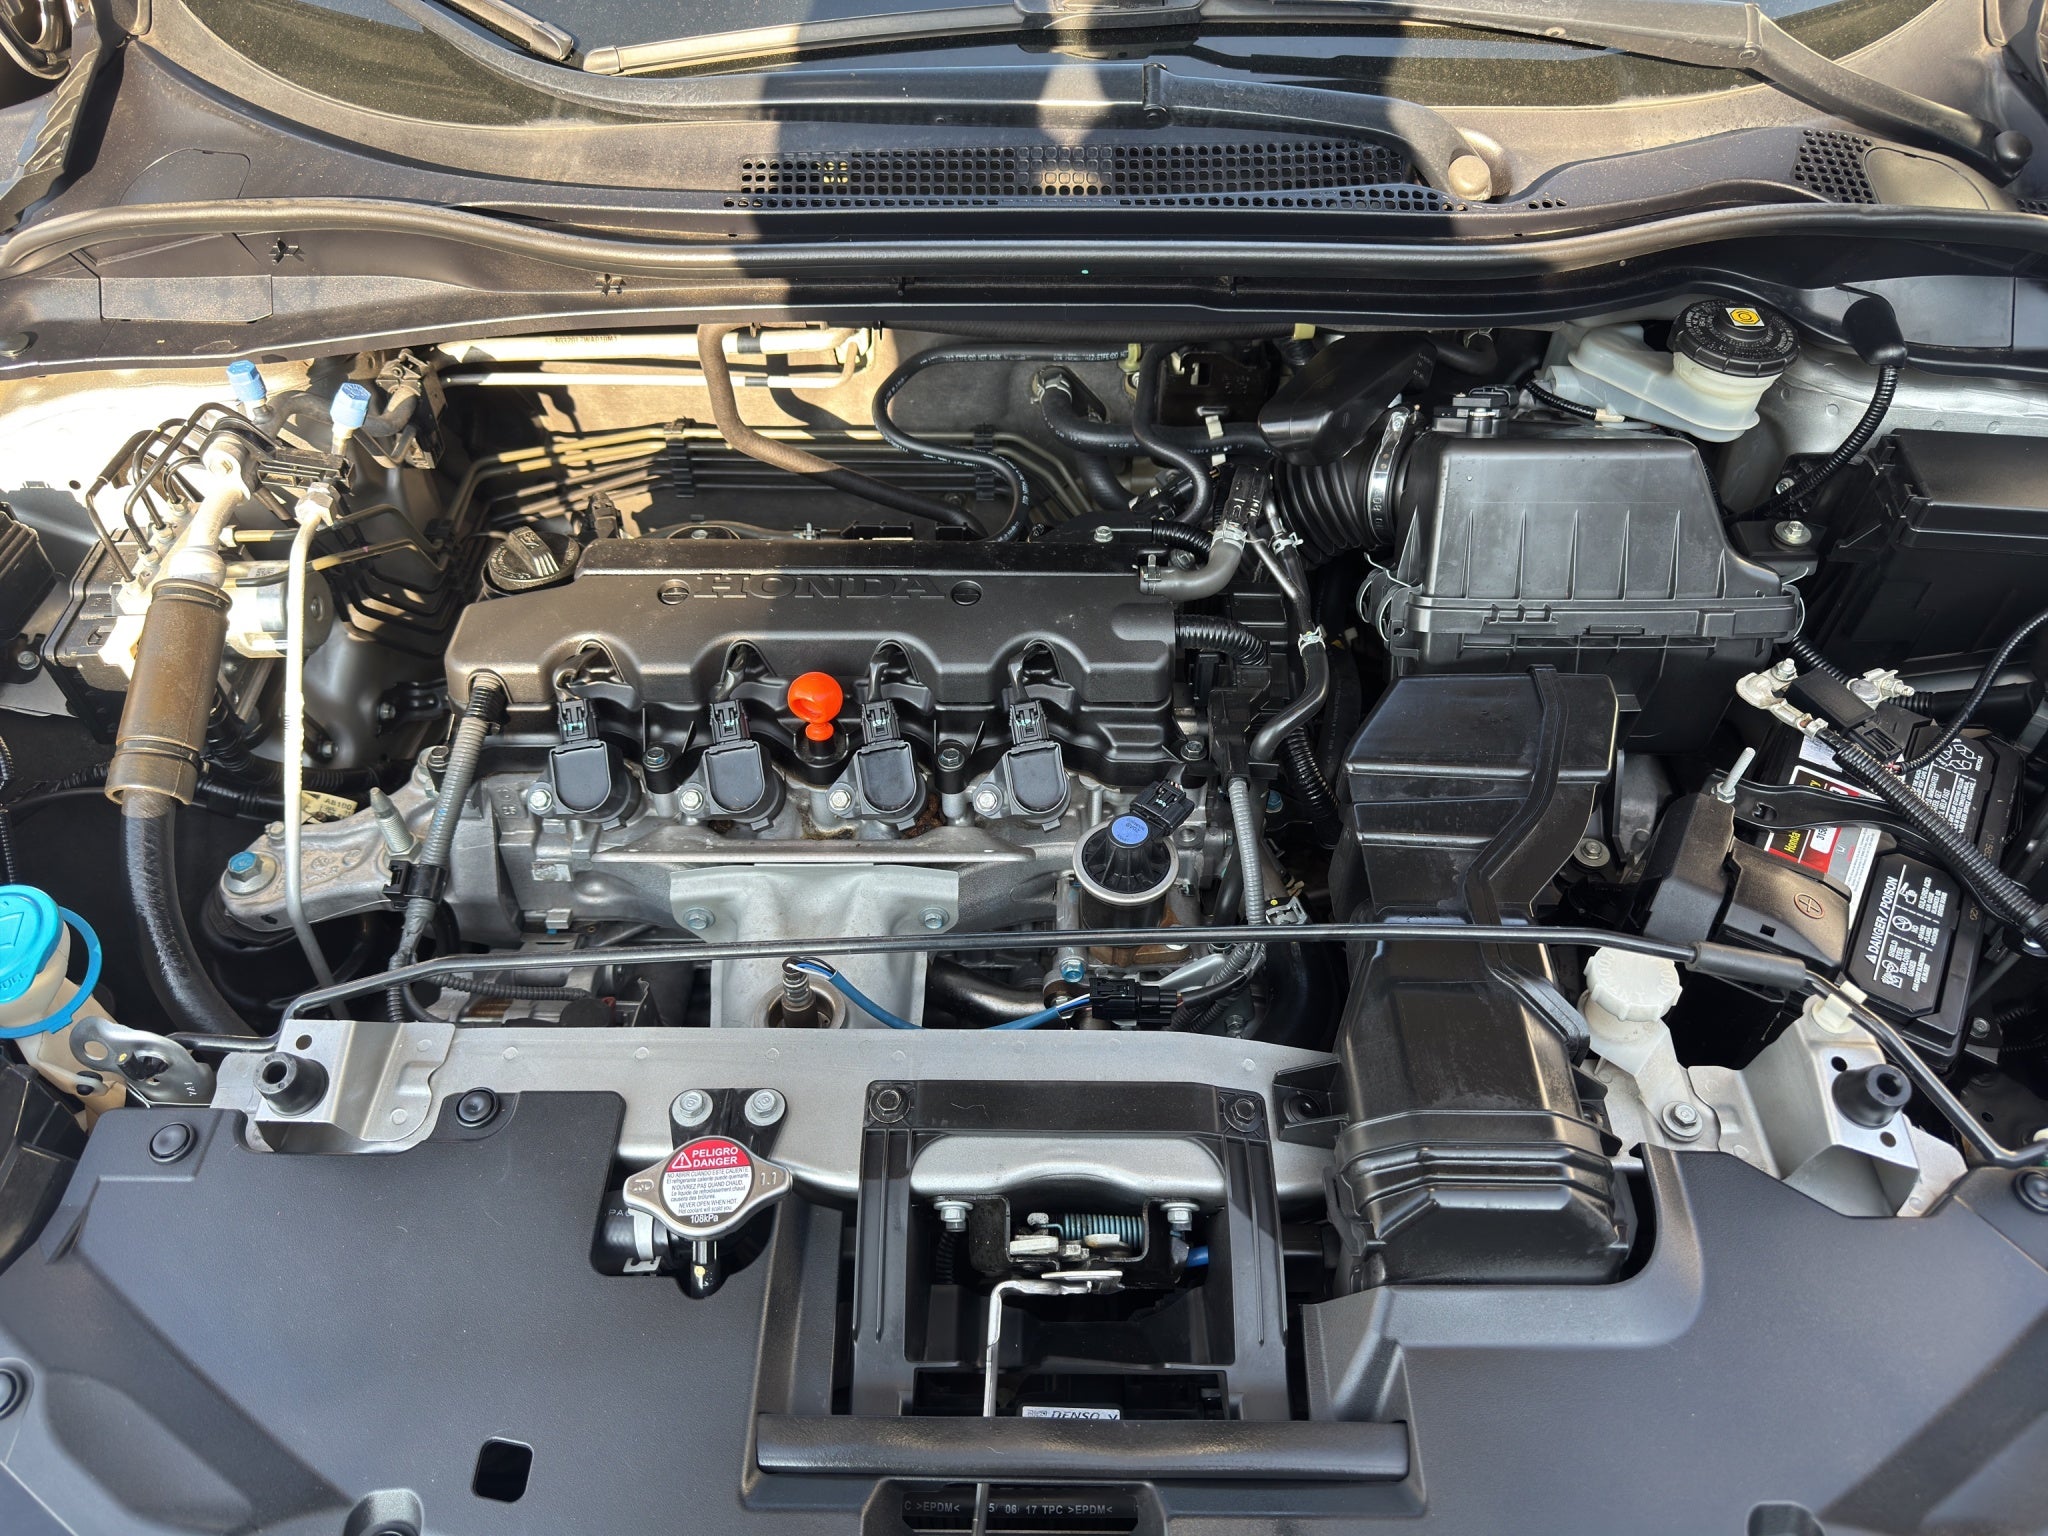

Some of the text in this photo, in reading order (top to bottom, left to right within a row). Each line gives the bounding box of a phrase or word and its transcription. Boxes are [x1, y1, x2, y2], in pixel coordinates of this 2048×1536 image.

[693, 574, 946, 599] HONDA
[1784, 831, 1801, 854] Honda
[1868, 916, 1884, 955] DANGER
[1880, 876, 1899, 910] POISON
[1911, 924, 1919, 934] NO
[1888, 940, 1898, 958] SHIELD
[1894, 947, 1904, 961] EYES
[1901, 947, 1912, 974] EXPLOSIVE
[1907, 960, 1917, 977] GASES
[692, 1147, 738, 1157] PELIGRO
[693, 1157, 738, 1168] DANGER
[690, 1214, 719, 1224] 108kPa
[1052, 1411, 1100, 1420] DENSO
[1026, 1505, 1037, 1513] 17
[1042, 1505, 1063, 1514] TPC
